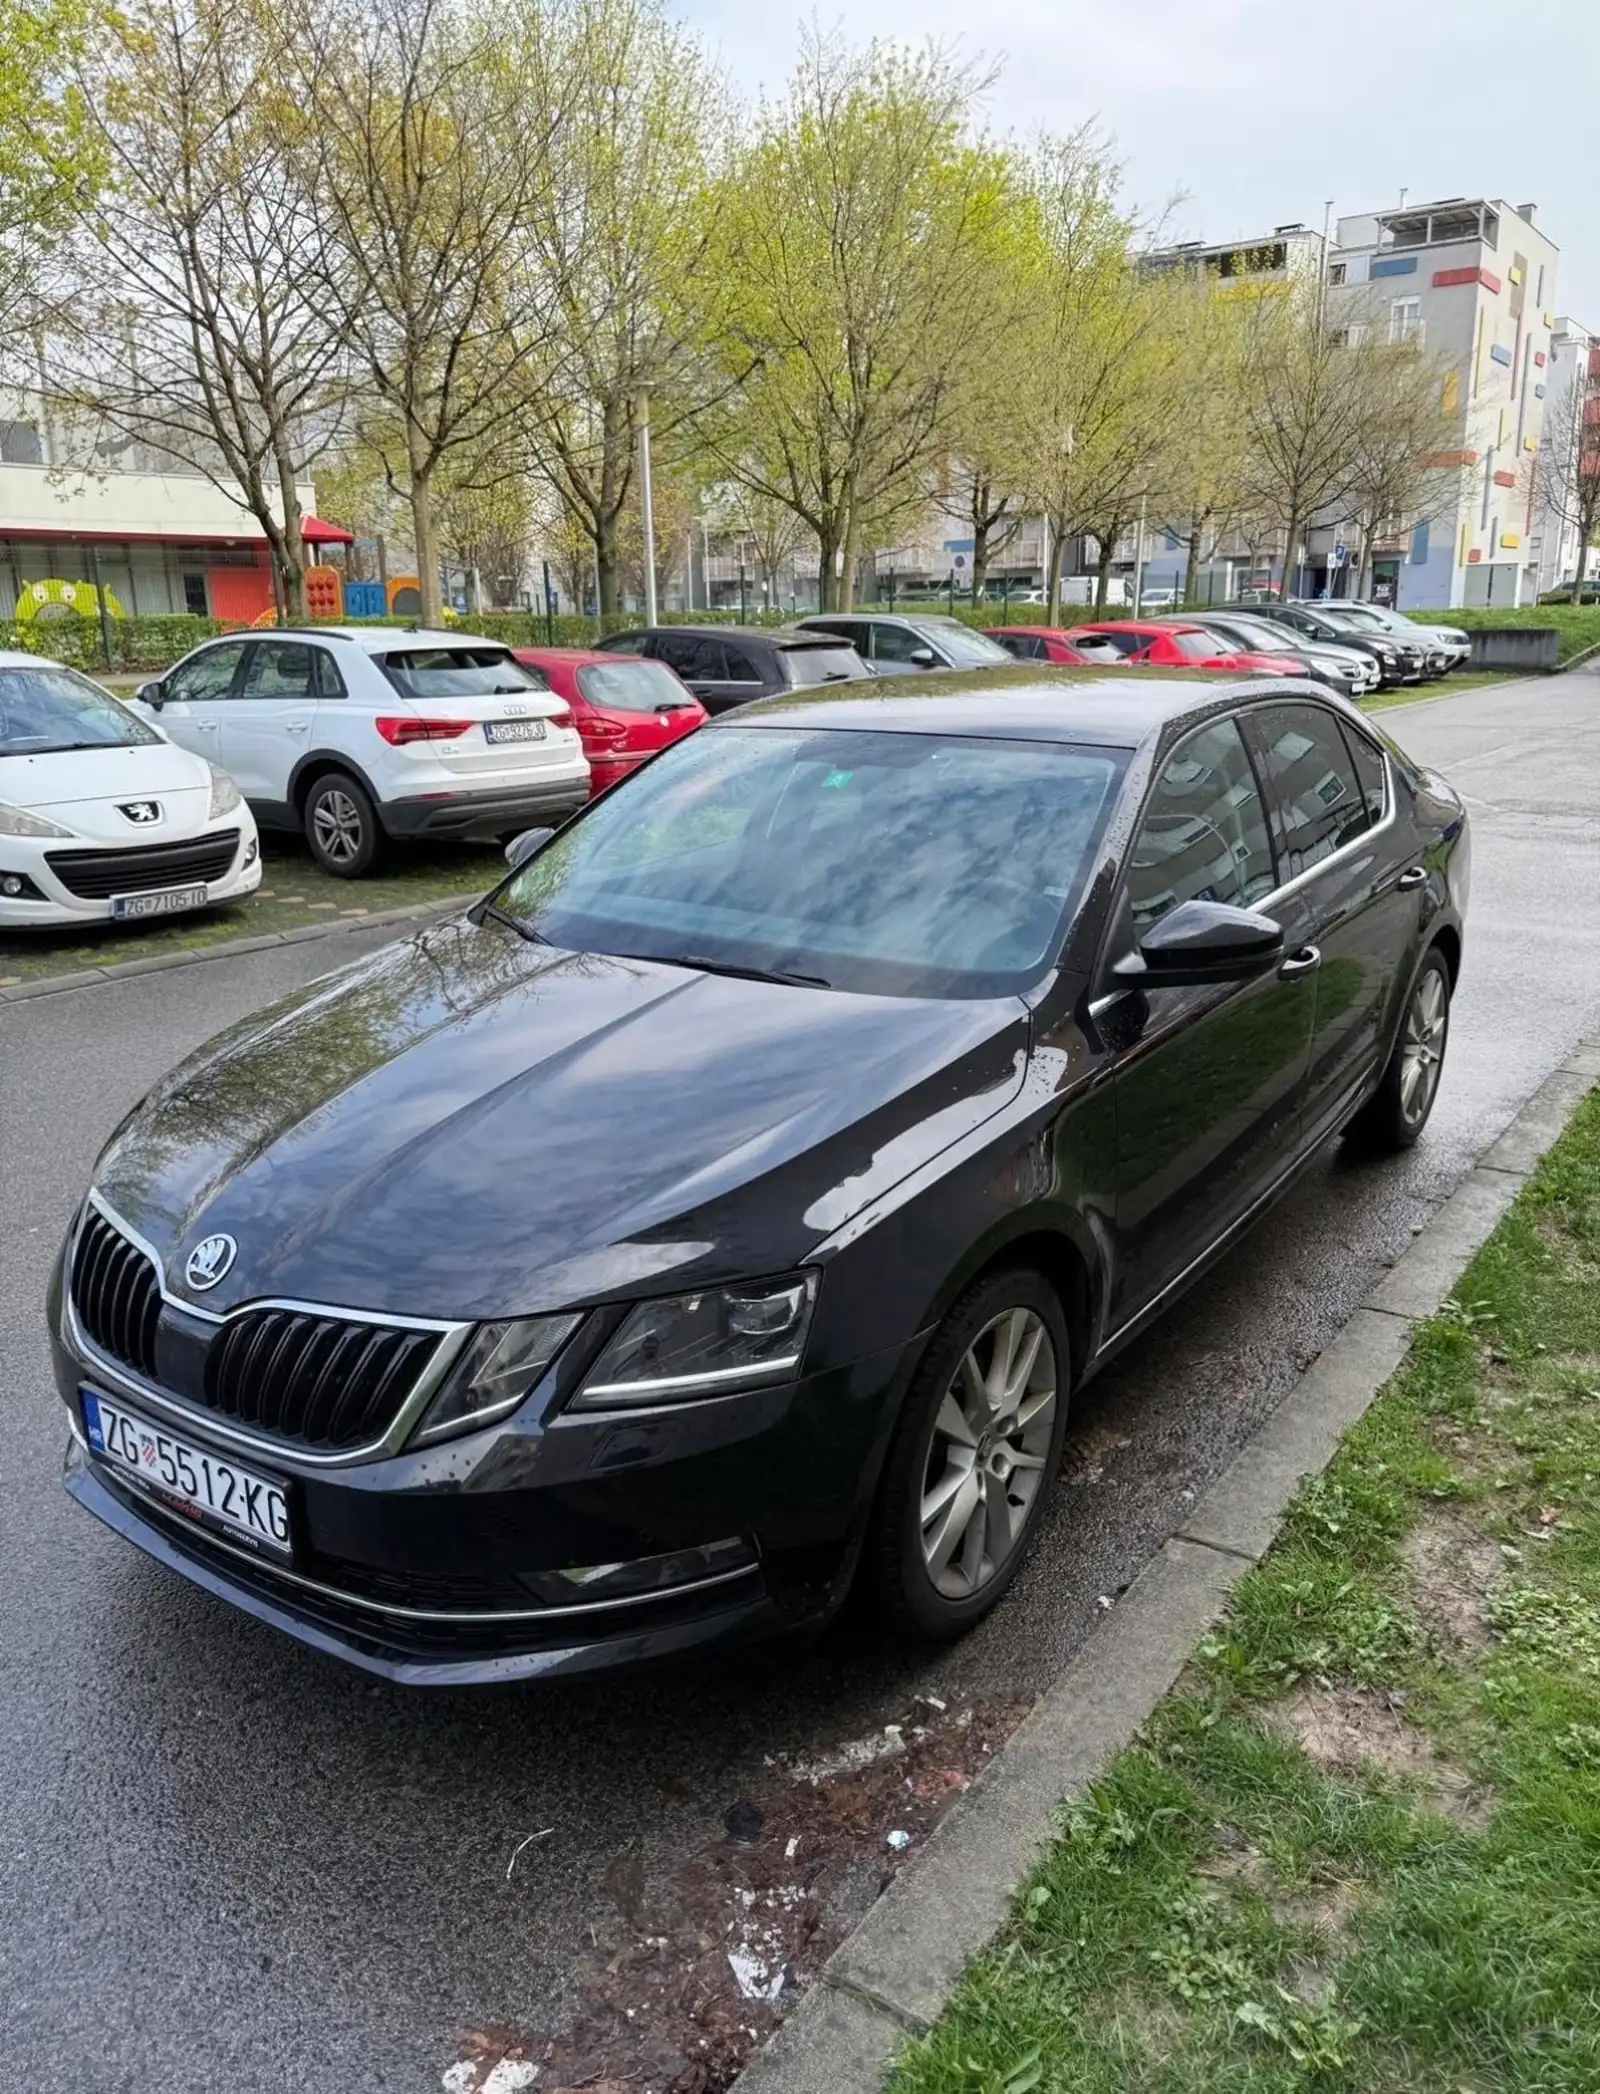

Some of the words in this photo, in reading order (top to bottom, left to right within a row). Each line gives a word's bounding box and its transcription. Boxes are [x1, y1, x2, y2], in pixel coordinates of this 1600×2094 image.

[127, 900, 144, 915] ZG
[101, 1406, 138, 1465] ZG
[156, 1435, 290, 1543] 5512-KG
